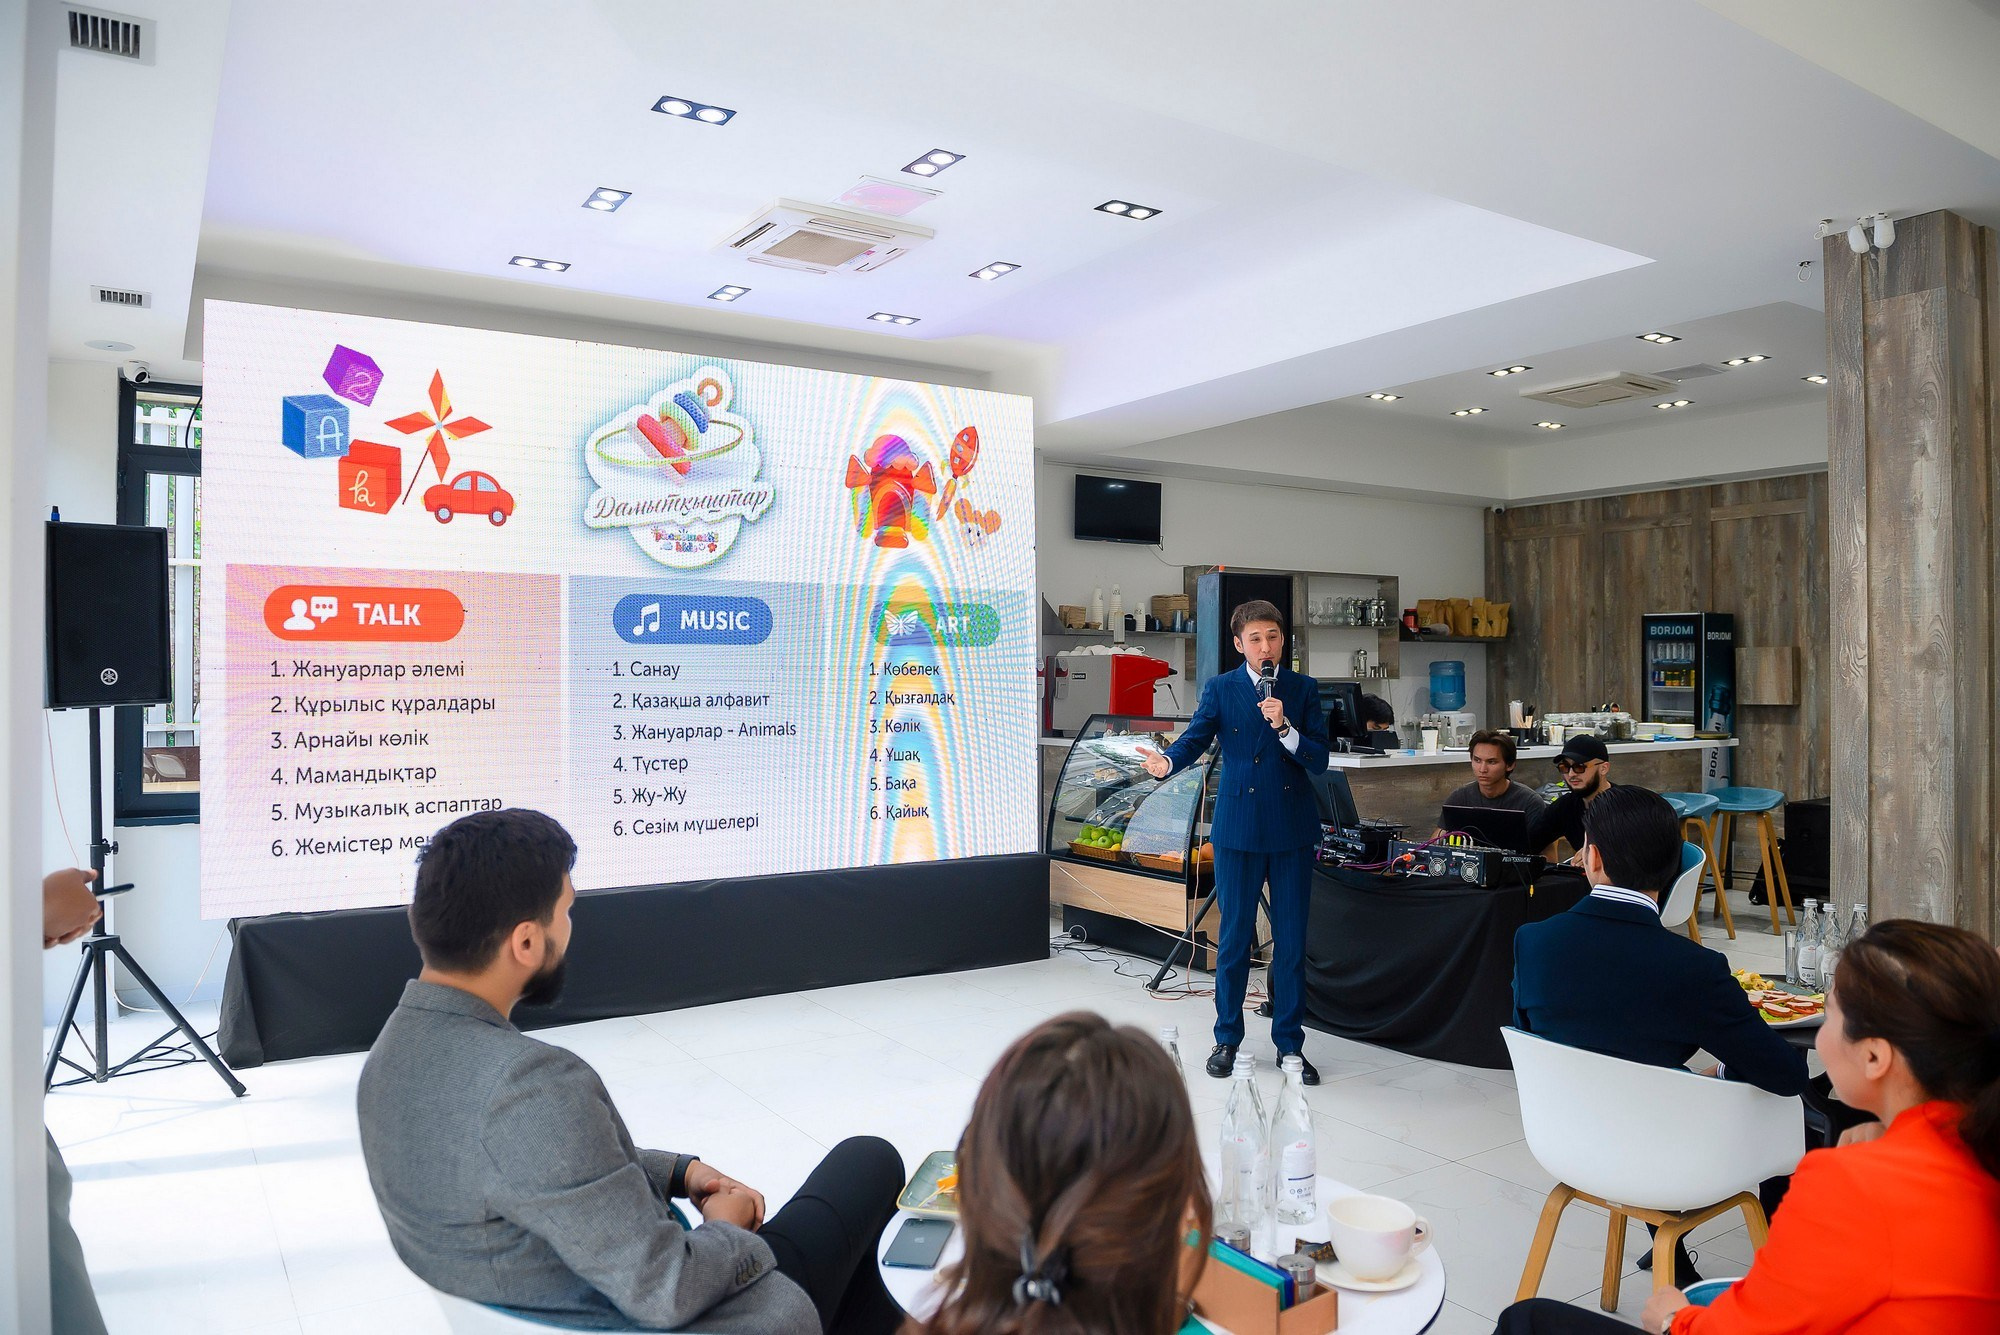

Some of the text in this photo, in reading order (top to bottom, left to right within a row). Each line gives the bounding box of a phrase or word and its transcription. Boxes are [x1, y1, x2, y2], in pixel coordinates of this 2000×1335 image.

[348, 371, 372, 401] 2
[352, 602, 421, 626] TALK
[680, 610, 750, 631] MUSIC
[935, 614, 971, 634] ART
[1650, 625, 1694, 636] BORJOMI
[1707, 632, 1731, 641] BORJOMI
[271, 661, 464, 681] 1. Жануарлар әлемі
[612, 662, 680, 680] 1. Санау
[869, 662, 939, 676] 1. Көбелек
[271, 696, 495, 716] 2. Құрылыс құралдары
[613, 692, 769, 711] 2. Қазақша алфавит
[869, 691, 954, 706] 2. Қызғалдақ
[613, 726, 627, 740] 3.
[632, 724, 723, 743] Жануарлар
[738, 722, 796, 737] Animals
[869, 719, 920, 734] 3. Көлік
[271, 730, 429, 752] 3. Арнайы көлік
[613, 756, 688, 774] 4. Түстер
[869, 748, 920, 764] 4. Ұшақ
[271, 765, 436, 784] 4. Мамандықтар
[870, 776, 916, 791] 5. Бақа
[613, 787, 687, 806] 5. Жу-Жу
[271, 799, 502, 823] 5. Музыкалық аспаптар
[870, 804, 929, 820] 6. Қайық
[613, 814, 759, 836] 6. Сезім мүшелері
[271, 840, 288, 857] 6.
[296, 837, 392, 856] Жемістер
